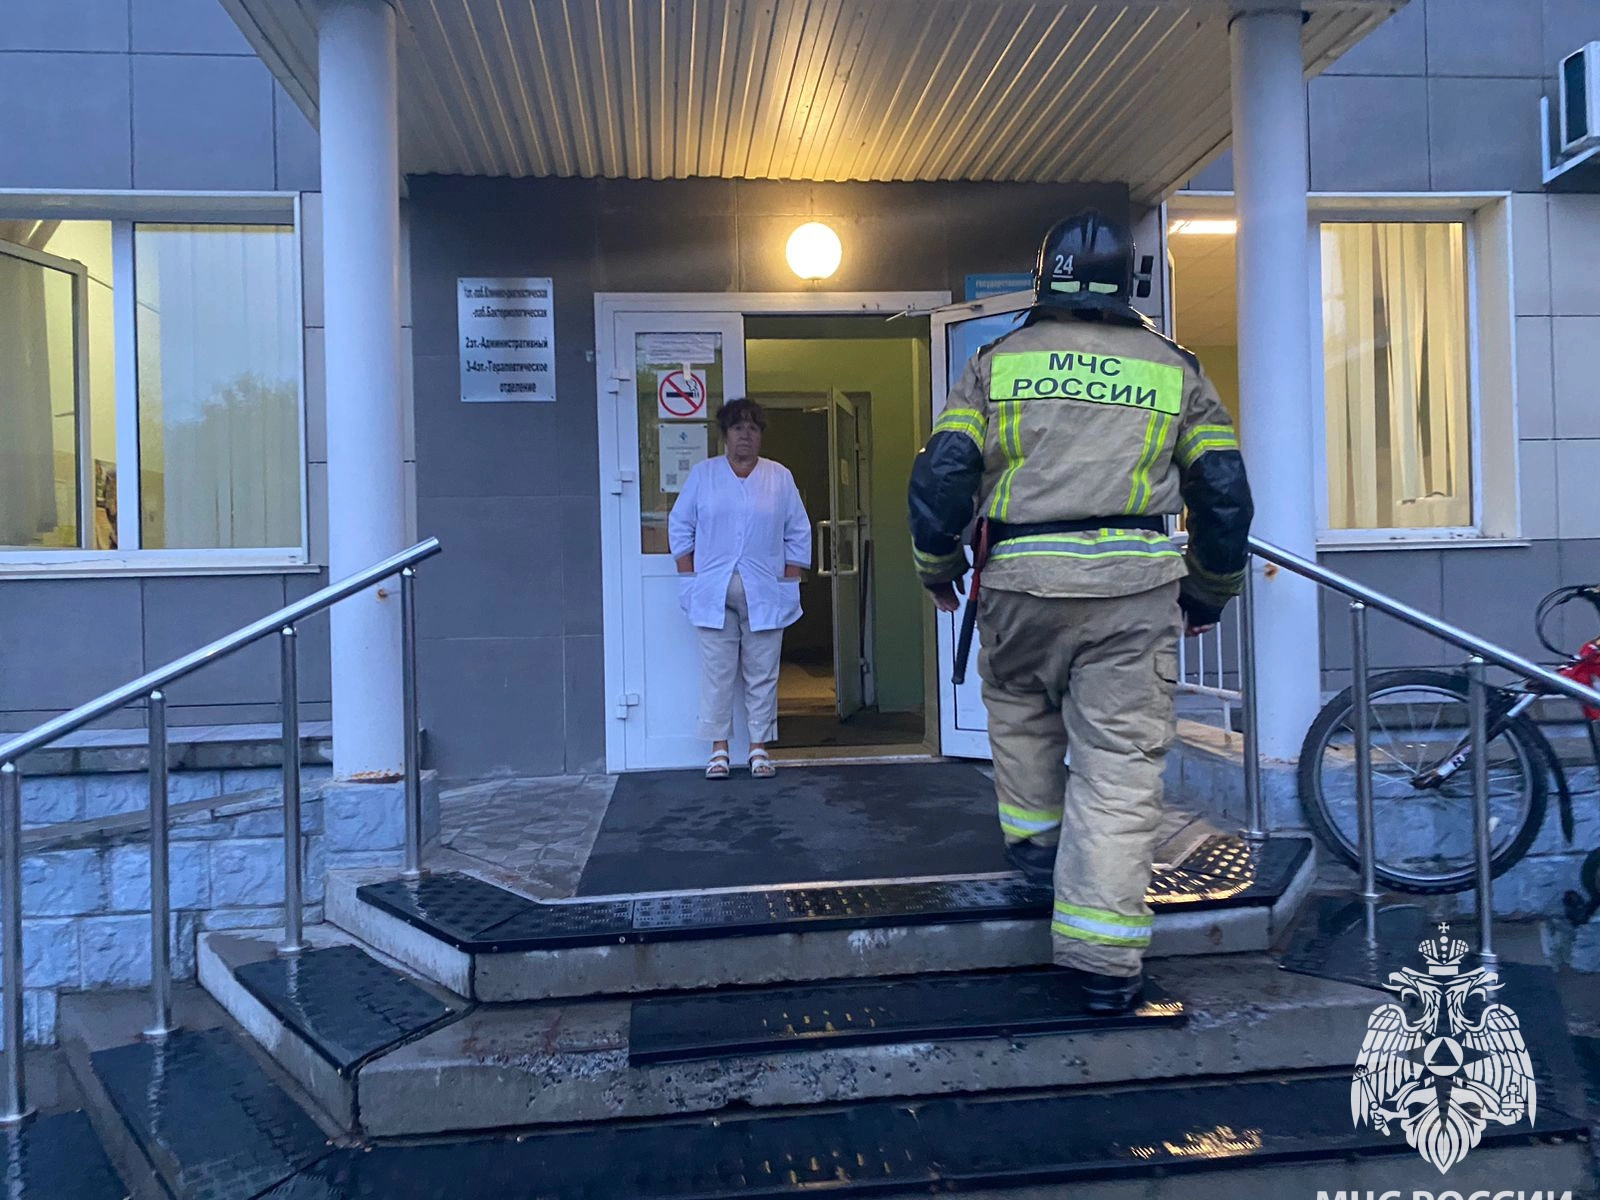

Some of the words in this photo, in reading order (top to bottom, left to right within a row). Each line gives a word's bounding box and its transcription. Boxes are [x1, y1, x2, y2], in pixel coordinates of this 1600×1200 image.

[1053, 254, 1074, 275] 24
[1048, 352, 1121, 377] МЧС
[1012, 377, 1157, 408] РОССИИ
